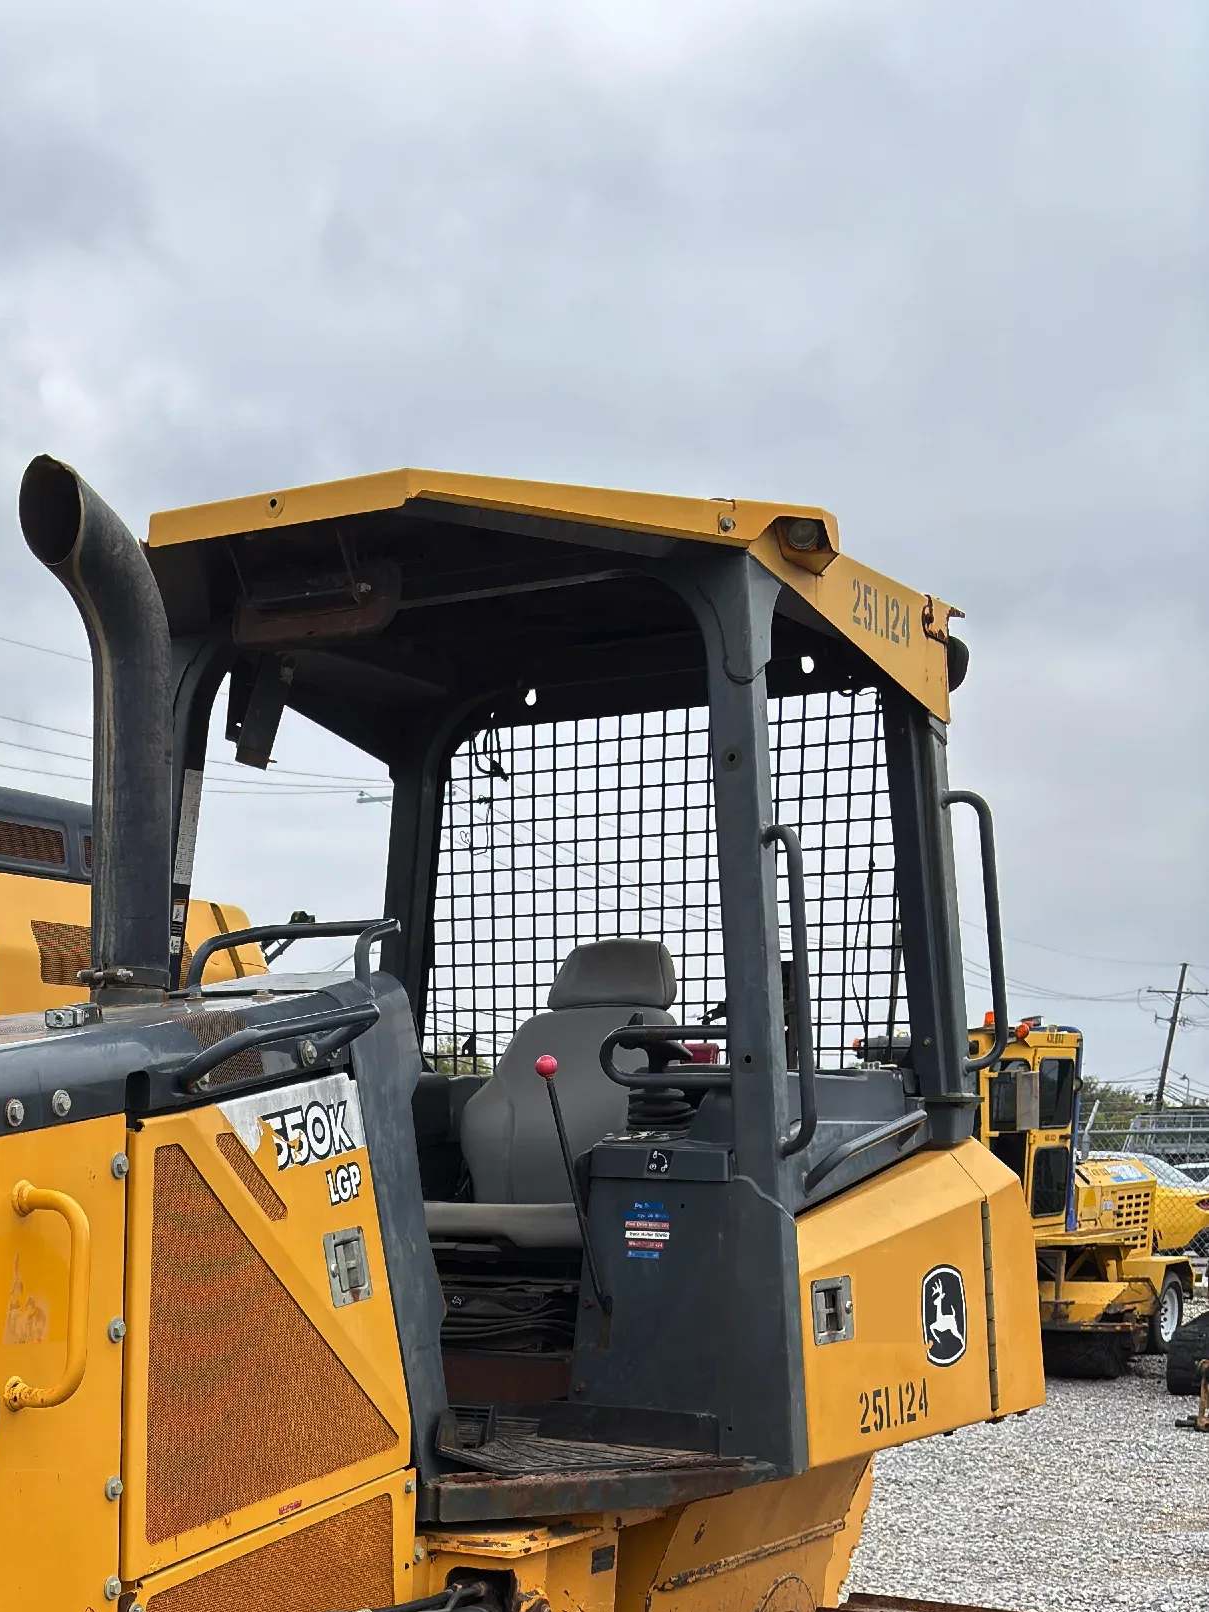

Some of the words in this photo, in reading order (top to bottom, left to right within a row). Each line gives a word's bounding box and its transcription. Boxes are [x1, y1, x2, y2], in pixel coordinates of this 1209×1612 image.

[852, 578, 910, 648] 251.124
[260, 1100, 357, 1171] 550K
[325, 1161, 362, 1206] LGP
[858, 1377, 929, 1434] 251.124
